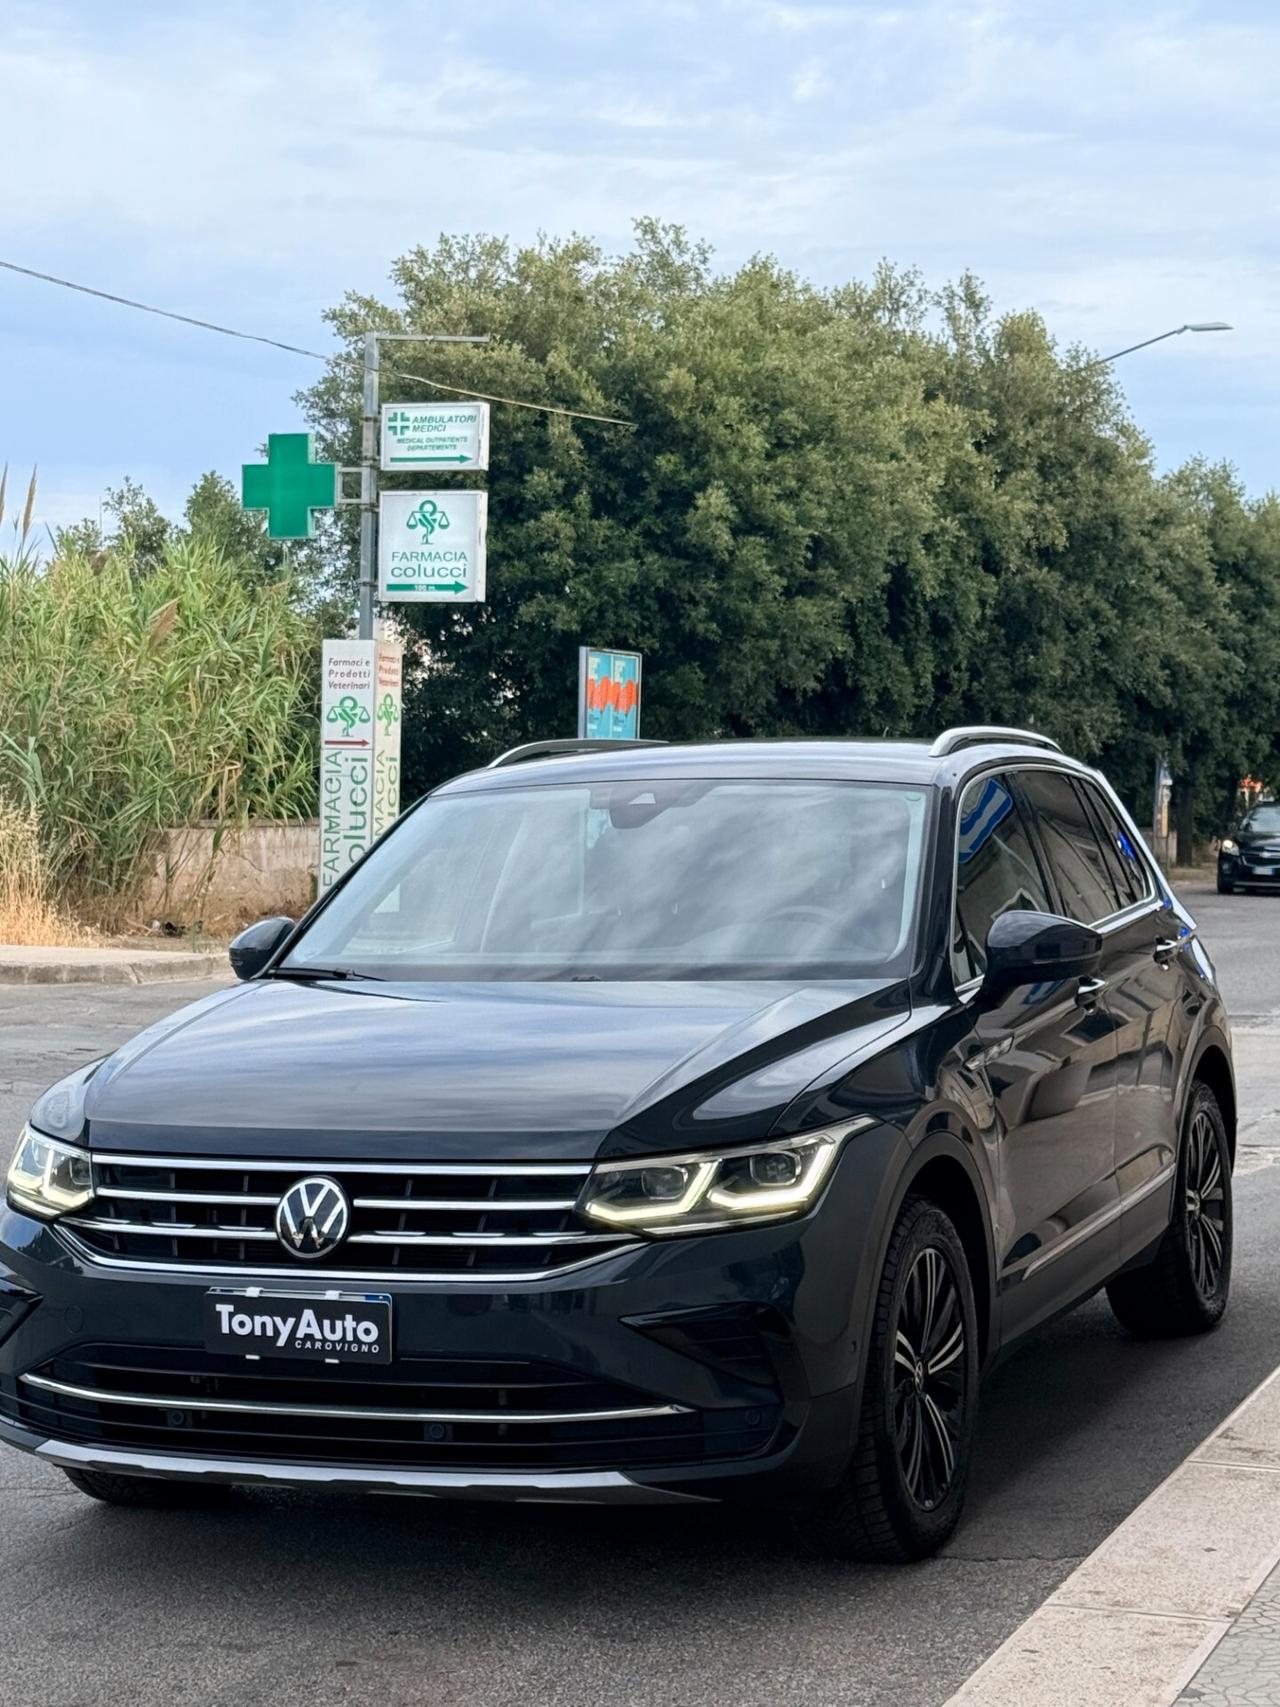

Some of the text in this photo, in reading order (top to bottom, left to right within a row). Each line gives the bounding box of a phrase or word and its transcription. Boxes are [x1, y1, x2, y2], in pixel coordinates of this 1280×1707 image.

[412, 415, 477, 424] AMBULATORI
[412, 424, 447, 433] MEDICI
[391, 551, 468, 562] FARMACIA
[391, 563, 467, 578] colucci
[328, 657, 370, 667] Farmaci e
[328, 669, 370, 678] Prodotti
[328, 680, 370, 690] Veterinari
[343, 756, 368, 864] olucci
[322, 750, 342, 887] FARMACIA
[215, 1303, 379, 1347] TonyAuto
[295, 1340, 379, 1353] CAROVIGNO
